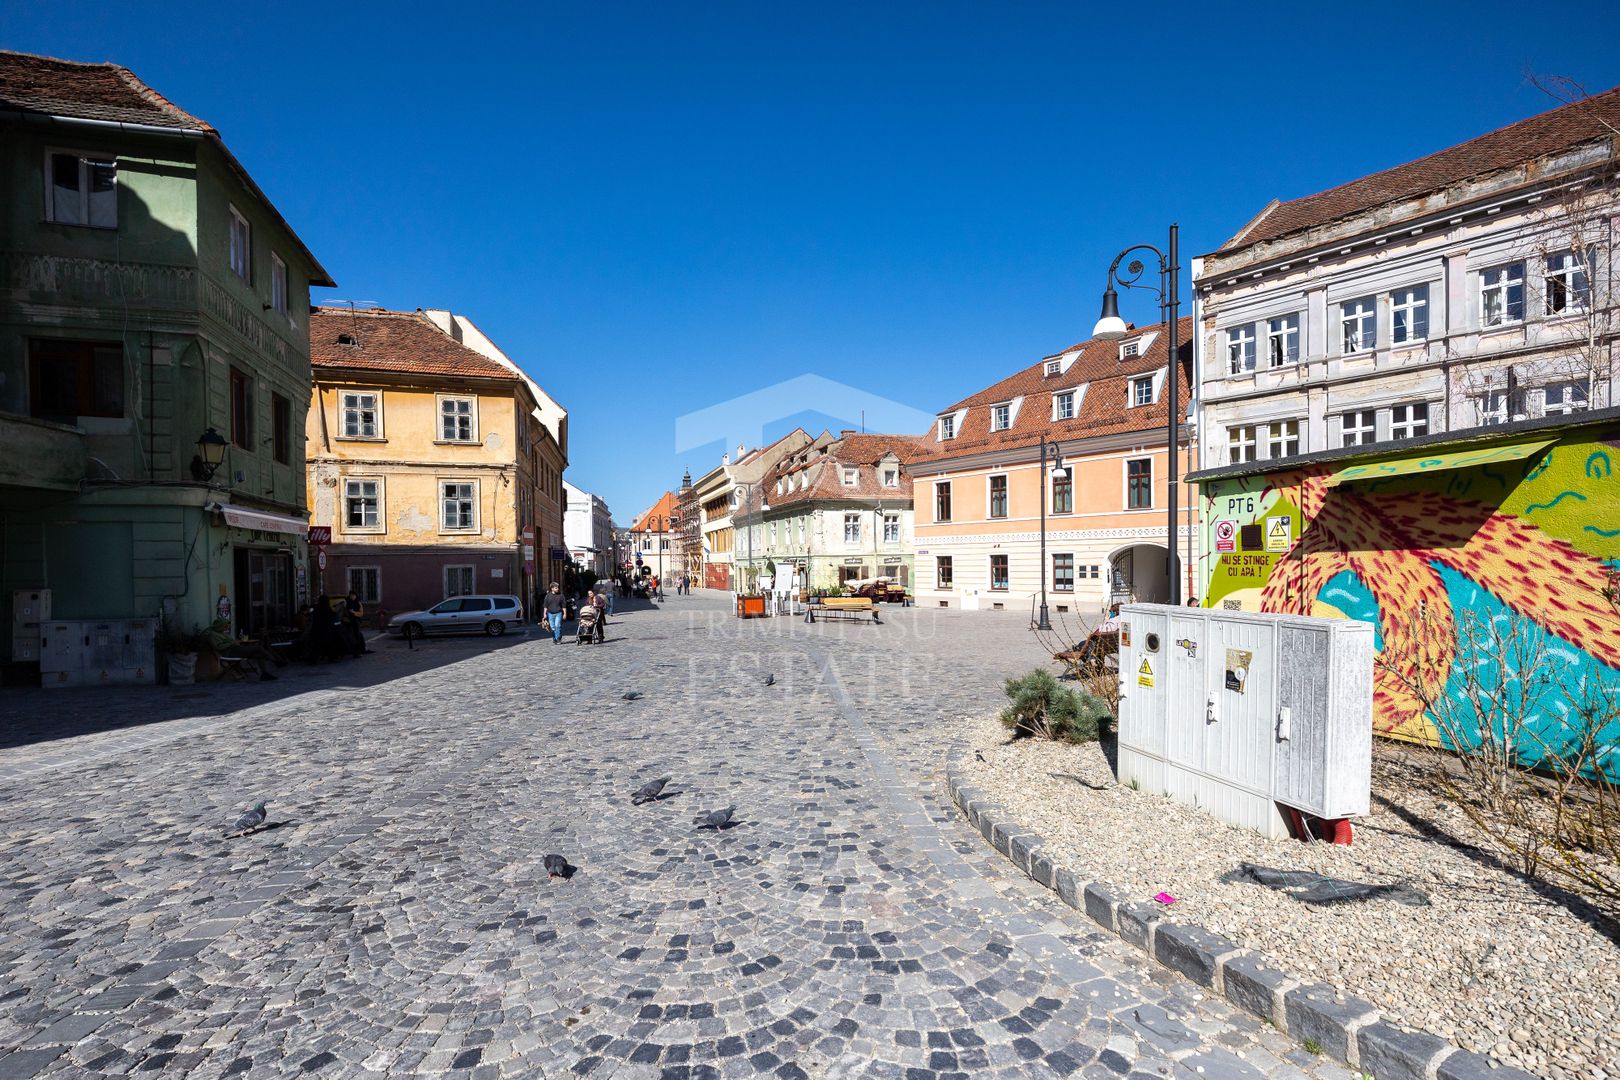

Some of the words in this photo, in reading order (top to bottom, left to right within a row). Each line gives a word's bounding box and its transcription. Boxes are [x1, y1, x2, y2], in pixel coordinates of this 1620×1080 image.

[311, 528, 331, 544] illy
[1221, 555, 1231, 565] NU
[1232, 555, 1241, 565] SE
[1243, 555, 1269, 566] STINGE
[1227, 567, 1237, 577] CU
